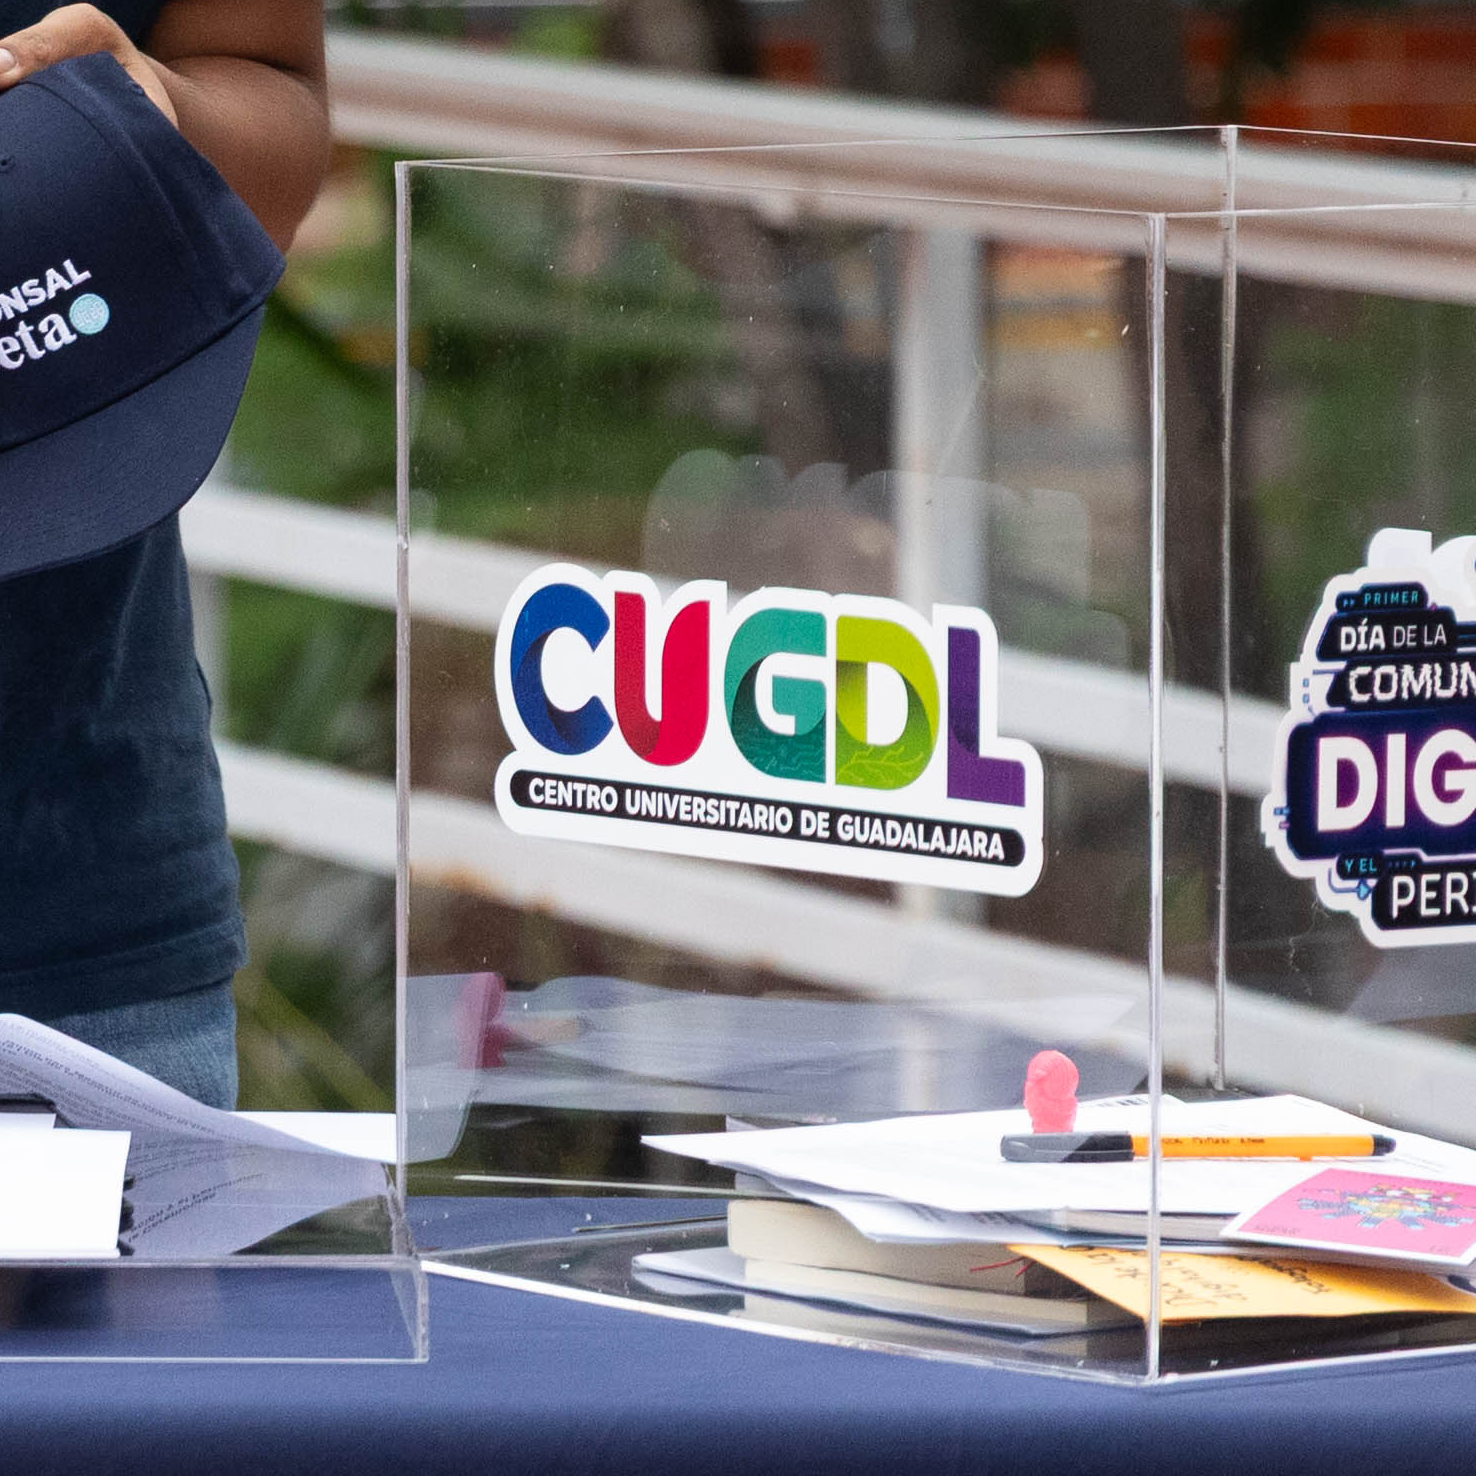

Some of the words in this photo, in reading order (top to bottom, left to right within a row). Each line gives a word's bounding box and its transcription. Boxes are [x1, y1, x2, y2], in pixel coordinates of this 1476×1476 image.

[1364, 591, 1419, 605] PRIMER
[1340, 618, 1386, 653] DÍA
[1393, 625, 1418, 647] DE
[1424, 624, 1447, 645] LA
[510, 583, 1025, 807] CUGDL
[528, 777, 618, 813] CENTRO
[625, 787, 793, 834] UNIVERSITARIO
[799, 809, 830, 838] DE
[837, 815, 1005, 861] GUADALAJARA
[1344, 859, 1355, 873] Y
[1359, 857, 1377, 873] EL
